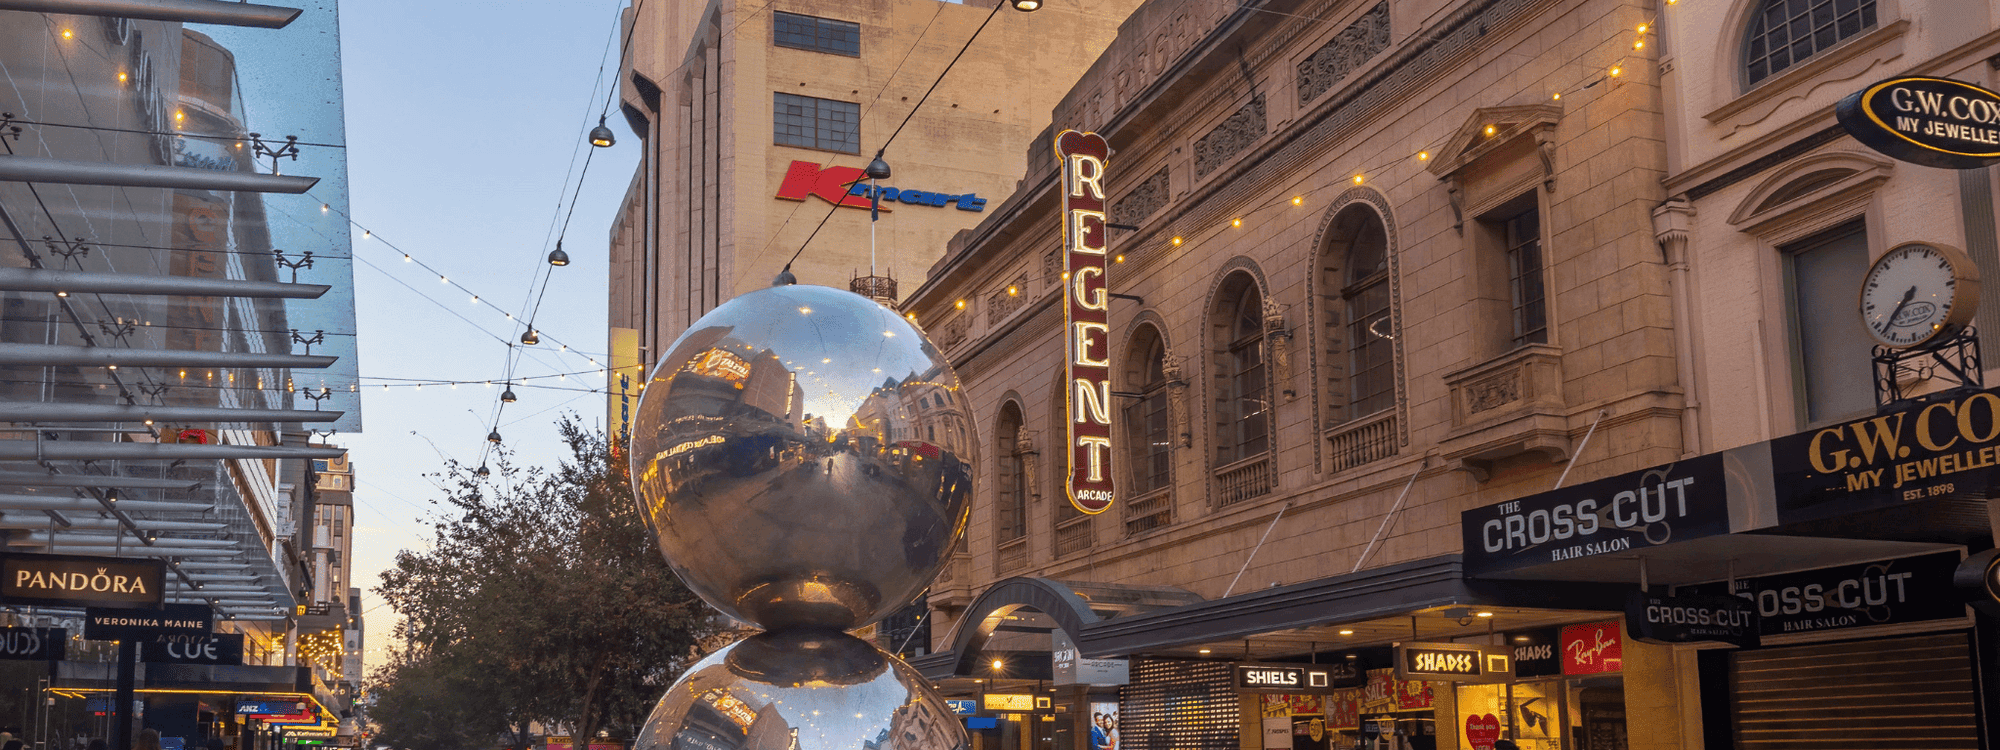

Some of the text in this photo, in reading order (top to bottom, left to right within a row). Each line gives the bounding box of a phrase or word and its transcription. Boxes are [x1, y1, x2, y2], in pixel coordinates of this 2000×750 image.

[1896, 116, 2000, 144] MY JEWELLE
[774, 160, 988, 212] Kmart
[1069, 153, 1113, 482] REGENT
[1846, 468, 1885, 492] MY
[1077, 489, 1113, 501] ARCADE
[1903, 483, 1955, 501] EST. 1898
[1483, 477, 1694, 553] CROSS CUT
[1498, 500, 1521, 516] THE
[1552, 537, 1630, 562] HAIR SALON
[16, 567, 147, 594] PANDORA
[1838, 572, 1912, 609] CUT
[95, 617, 203, 629] VERONIKA MAINE
[1646, 606, 1752, 628] CROSS CUT
[1783, 615, 1857, 632] HAIR SALON
[167, 638, 219, 660] CUE
[1514, 645, 1552, 661] SHADES
[1416, 653, 1472, 672] SHADES
[1247, 671, 1297, 685] SHIELS
[1365, 681, 1388, 701] SALE
[239, 705, 258, 713] ANZ
